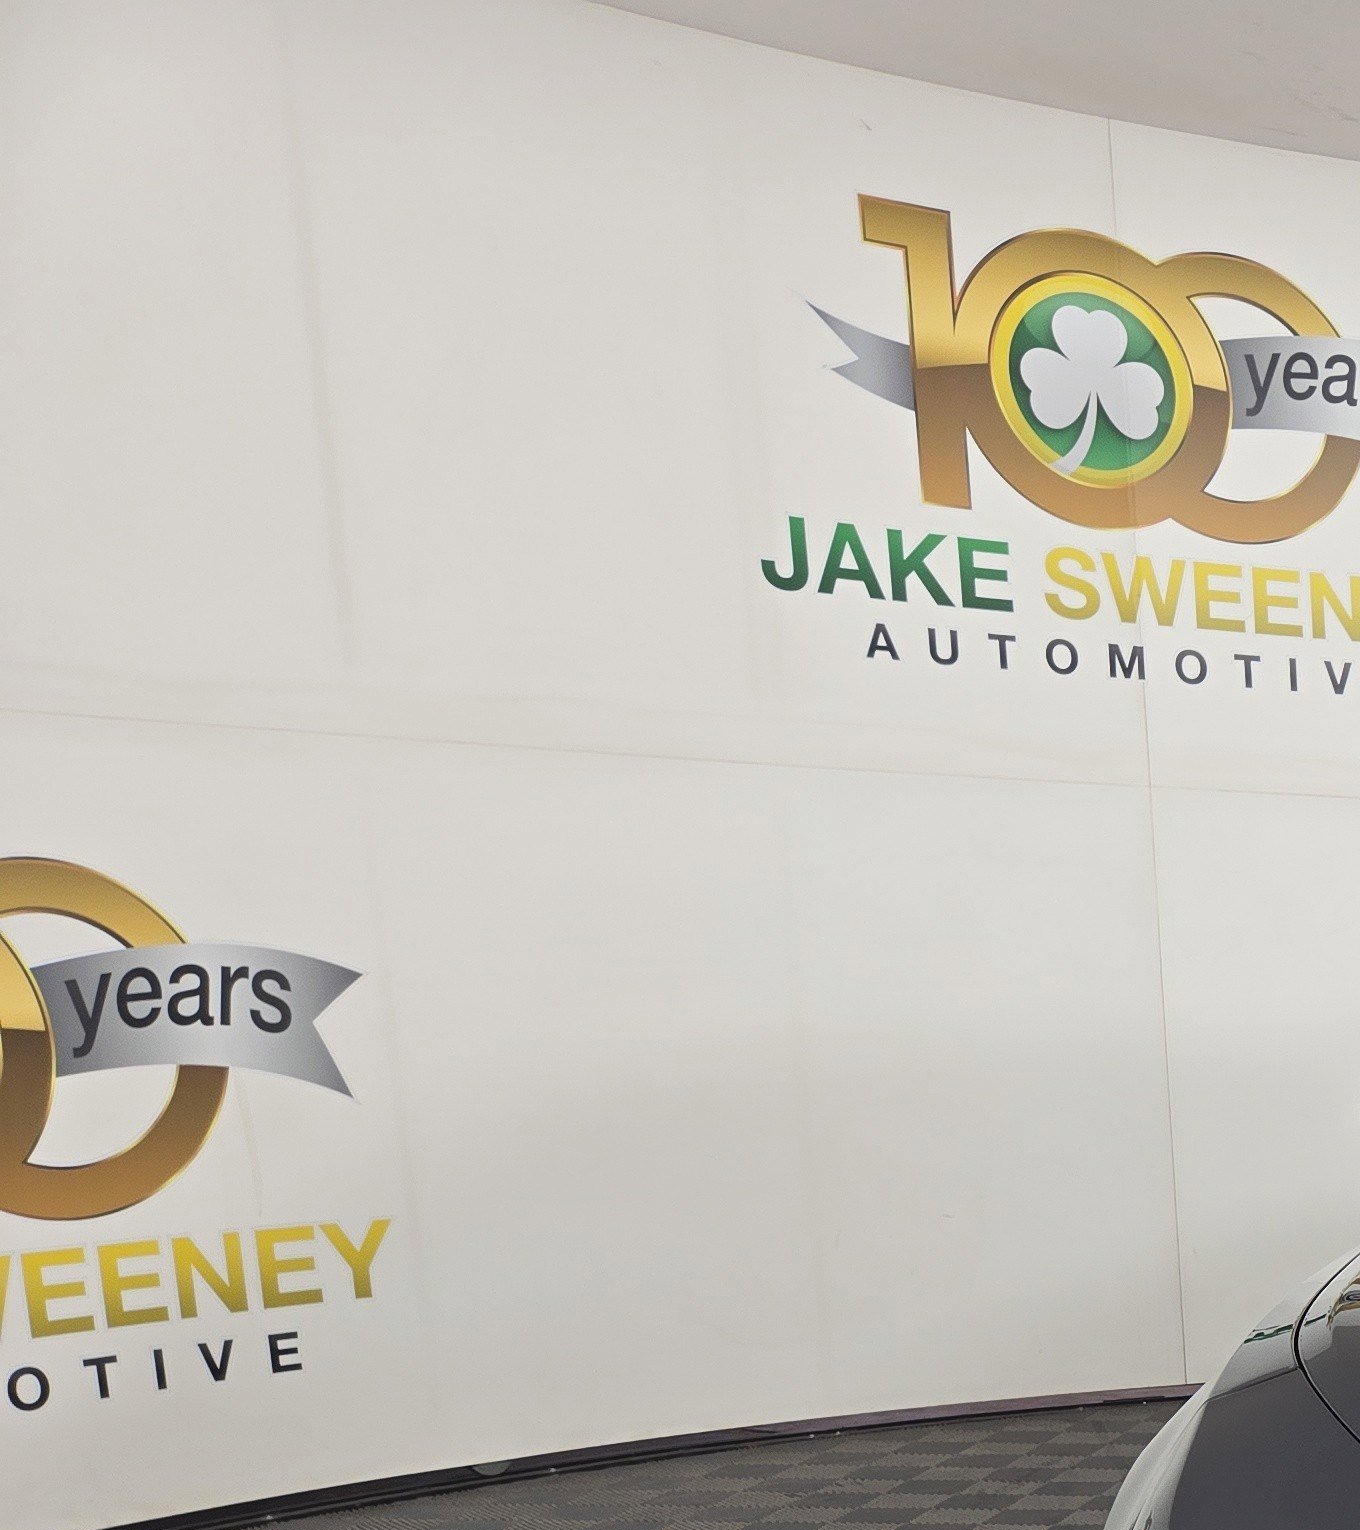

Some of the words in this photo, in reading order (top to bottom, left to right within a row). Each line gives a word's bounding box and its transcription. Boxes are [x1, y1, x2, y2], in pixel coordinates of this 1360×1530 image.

[760, 515, 1015, 613] JAKE
[64, 963, 293, 1059] years
[0, 1219, 391, 1343] EENEY
